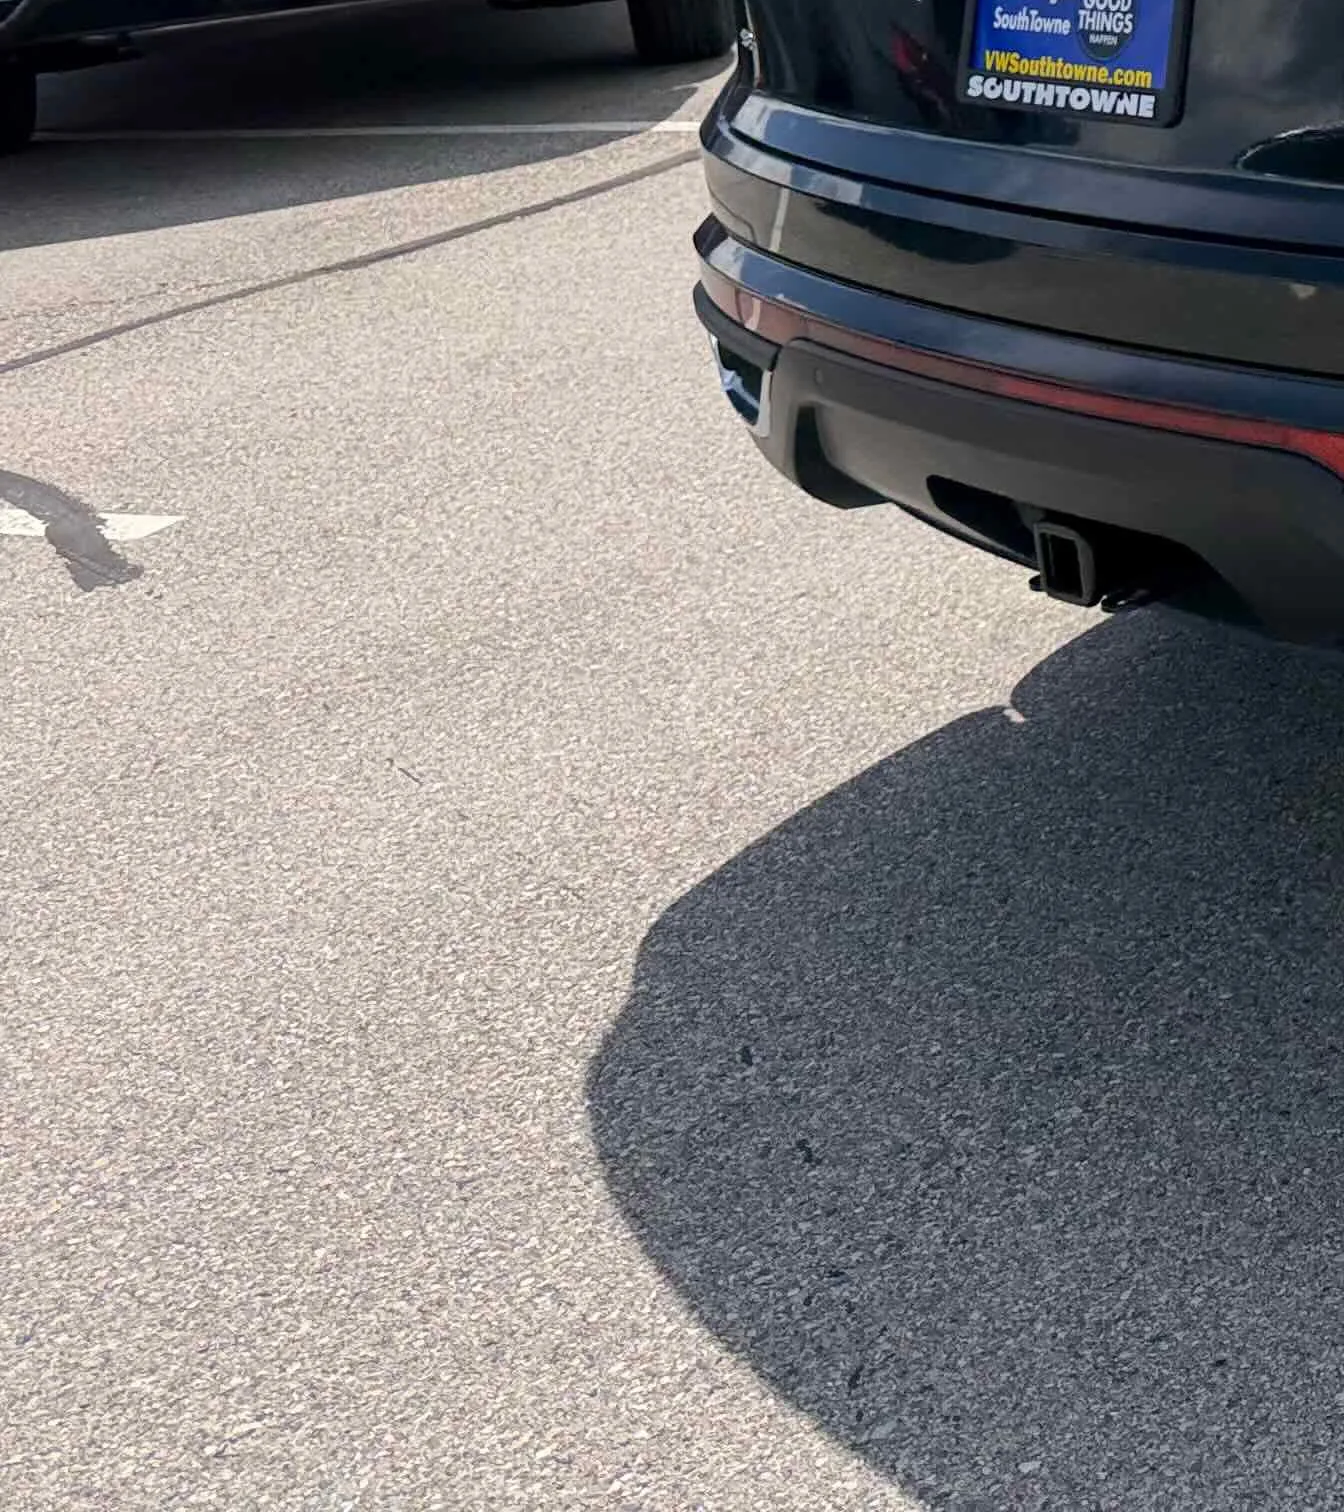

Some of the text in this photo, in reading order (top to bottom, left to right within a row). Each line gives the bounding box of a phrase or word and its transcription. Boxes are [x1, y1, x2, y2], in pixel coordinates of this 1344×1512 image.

[993, 6, 1071, 35] SouthTowne
[1078, 9, 1133, 34] THINGS
[985, 50, 1153, 88] VWSouthtowne.com
[967, 75, 1156, 118] SOUTHTOWNE
